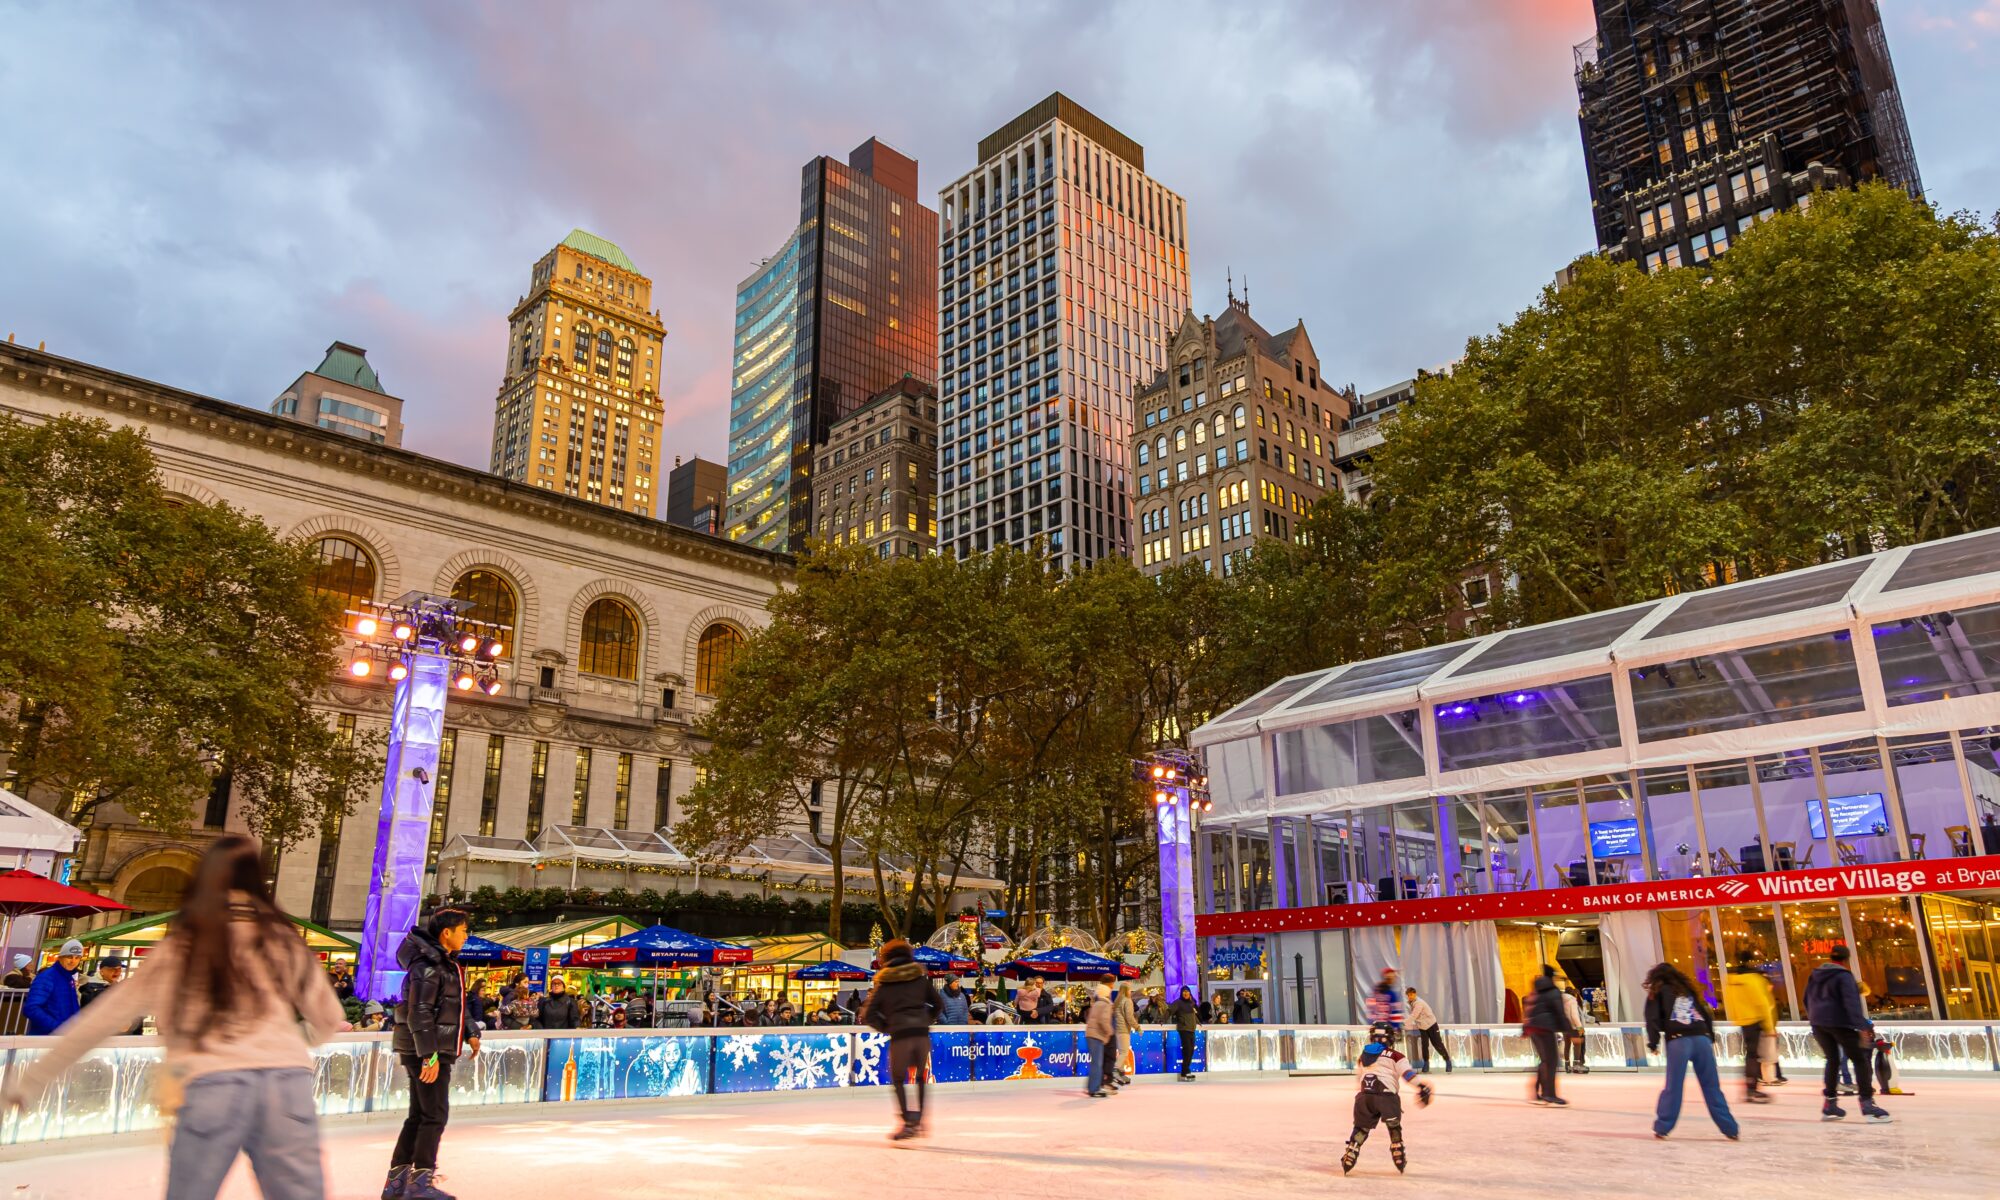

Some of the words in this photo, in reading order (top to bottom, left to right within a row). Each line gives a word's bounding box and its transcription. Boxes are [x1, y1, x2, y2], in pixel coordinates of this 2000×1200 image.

[1583, 894, 1621, 906] BANK
[1624, 893, 1643, 903] OF
[1647, 888, 1715, 902] AMERICA
[1757, 876, 1838, 896] Winter
[1839, 868, 1927, 892] Village
[1936, 870, 1955, 884] at
[1215, 952, 1259, 962] OVERLOOK
[951, 1042, 984, 1060] magic
[987, 1041, 1011, 1056] hour
[1048, 1052, 1073, 1066] every
[1075, 1049, 1092, 1063] hou
[1381, 1049, 1393, 1058] AN
